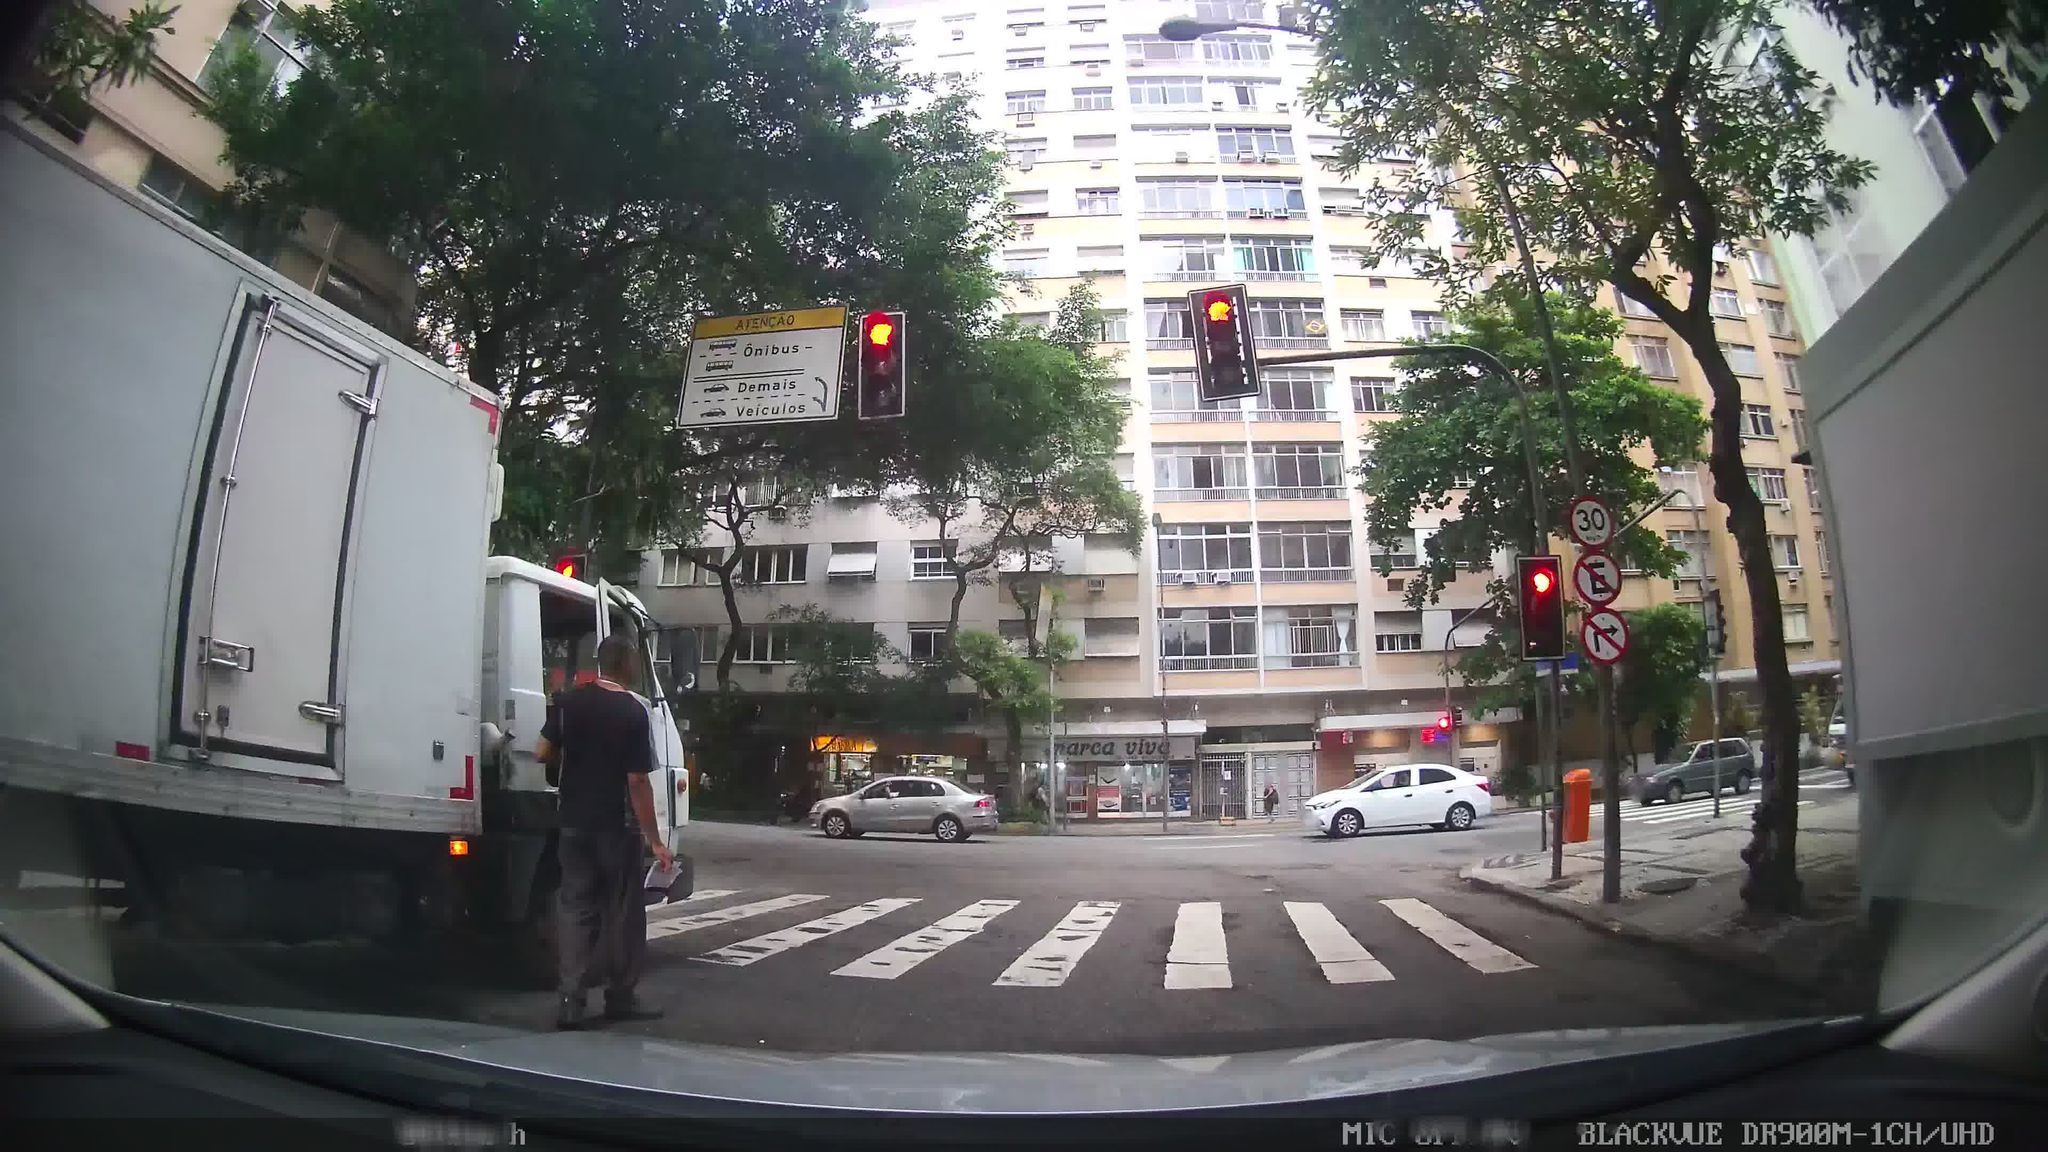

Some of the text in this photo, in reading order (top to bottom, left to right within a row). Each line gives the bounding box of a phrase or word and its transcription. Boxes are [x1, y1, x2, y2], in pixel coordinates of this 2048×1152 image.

[735, 313, 796, 331] ATENÇÃO
[743, 343, 800, 357] Ônibus
[737, 380, 797, 394] Demais
[736, 402, 807, 417] Veículos
[1575, 508, 1605, 532] 30
